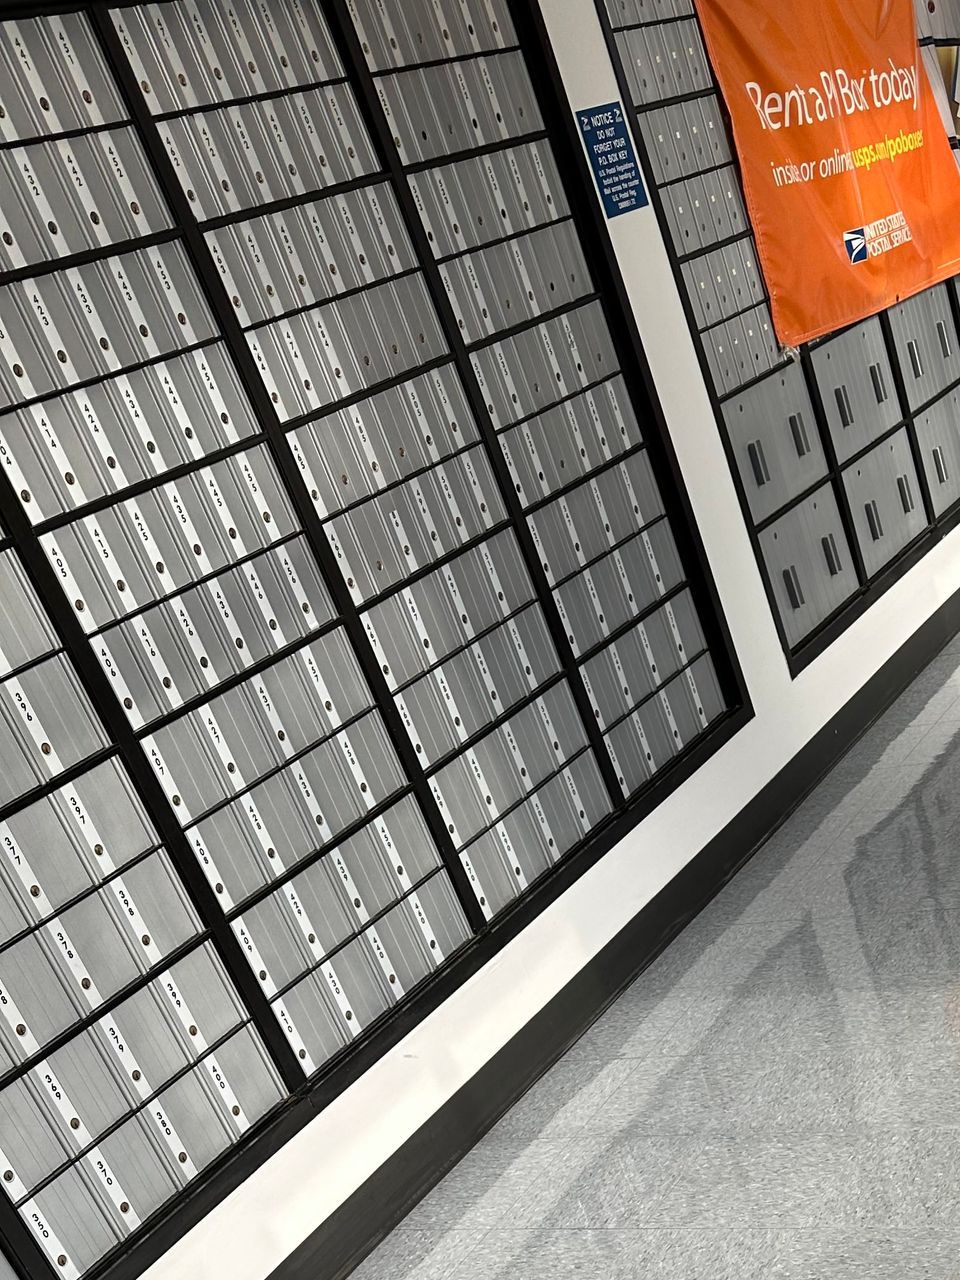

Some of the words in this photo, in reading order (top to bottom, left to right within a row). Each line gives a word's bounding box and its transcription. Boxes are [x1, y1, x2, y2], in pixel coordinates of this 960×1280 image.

[119, 24, 133, 55] 461
[157, 19, 170, 47] 471
[15, 38, 31, 71] 441
[59, 32, 74, 64] 451
[745, 82, 813, 130] Rent
[809, 87, 827, 121] a
[869, 58, 917, 111] today
[301, 106, 313, 134] 502
[591, 112, 613, 127] NOTICE
[202, 128, 216, 157] 472
[236, 121, 250, 149] 482
[594, 141, 612, 154] FORGET
[613, 138, 626, 148] YOUR
[597, 130, 605, 140] DO
[606, 127, 615, 137] NOT
[109, 147, 123, 177] 452
[166, 137, 180, 166] 462
[609, 153, 618, 163] BOX
[619, 150, 627, 160] KEY
[24, 164, 40, 196] 432
[67, 155, 83, 186] 442
[801, 160, 816, 182] or
[312, 216, 324, 243] 493
[342, 207, 354, 234] 503
[248, 235, 260, 263] 473
[281, 226, 293, 254] 483
[213, 246, 226, 274] 463
[118, 272, 132, 301] 443
[157, 261, 171, 290] 453
[33, 295, 49, 325] 423
[77, 284, 92, 313] 433
[286, 331, 298, 359] 474
[318, 321, 329, 347] 484
[252, 344, 266, 371] 464
[201, 364, 214, 390] 454
[164, 377, 178, 404] 444
[125, 390, 139, 418] 434
[411, 393, 421, 417] 505
[84, 404, 99, 433] 424
[41, 419, 56, 448] 414
[0, 441, 12, 466] 04
[294, 444, 305, 470] 465
[244, 465, 257, 492] 455
[209, 480, 222, 507] 445
[173, 496, 186, 523] 435
[134, 513, 148, 541] 425
[94, 529, 109, 558] 415
[331, 534, 342, 558] 466
[52, 548, 67, 577] 405
[284, 559, 296, 584] 456
[251, 574, 263, 599] 446
[216, 592, 229, 618] 436
[179, 610, 193, 636] 426
[367, 624, 376, 647] 467
[141, 629, 155, 657] 416
[101, 649, 116, 677] 406
[308, 658, 319, 682] 457
[15, 693, 32, 721] 396
[259, 687, 271, 711] 437
[400, 704, 410, 727] 468
[208, 718, 220, 743] 427
[151, 749, 164, 775] 407
[344, 742, 355, 765] 458
[298, 774, 310, 797] 438
[433, 787, 443, 808] 469
[70, 798, 85, 824] 397
[249, 806, 261, 829] 428
[381, 827, 391, 848] 459
[4, 837, 21, 865] 377
[196, 840, 209, 864] 408
[337, 859, 348, 882] 439
[465, 861, 475, 881] 470
[119, 890, 134, 916] 398
[290, 893, 301, 915] 429
[415, 903, 425, 924] 460
[57, 932, 74, 958] 378
[240, 929, 252, 952] 409
[373, 937, 384, 958] 440
[167, 983, 181, 1008] 399
[329, 973, 340, 994] 430
[280, 1010, 292, 1033] 410
[109, 1028, 124, 1052] 379
[45, 1075, 61, 1100] 369
[212, 1066, 225, 1089] 400
[156, 1112, 171, 1135] 380
[97, 1161, 112, 1185] 370
[32, 1214, 49, 1238] 350
